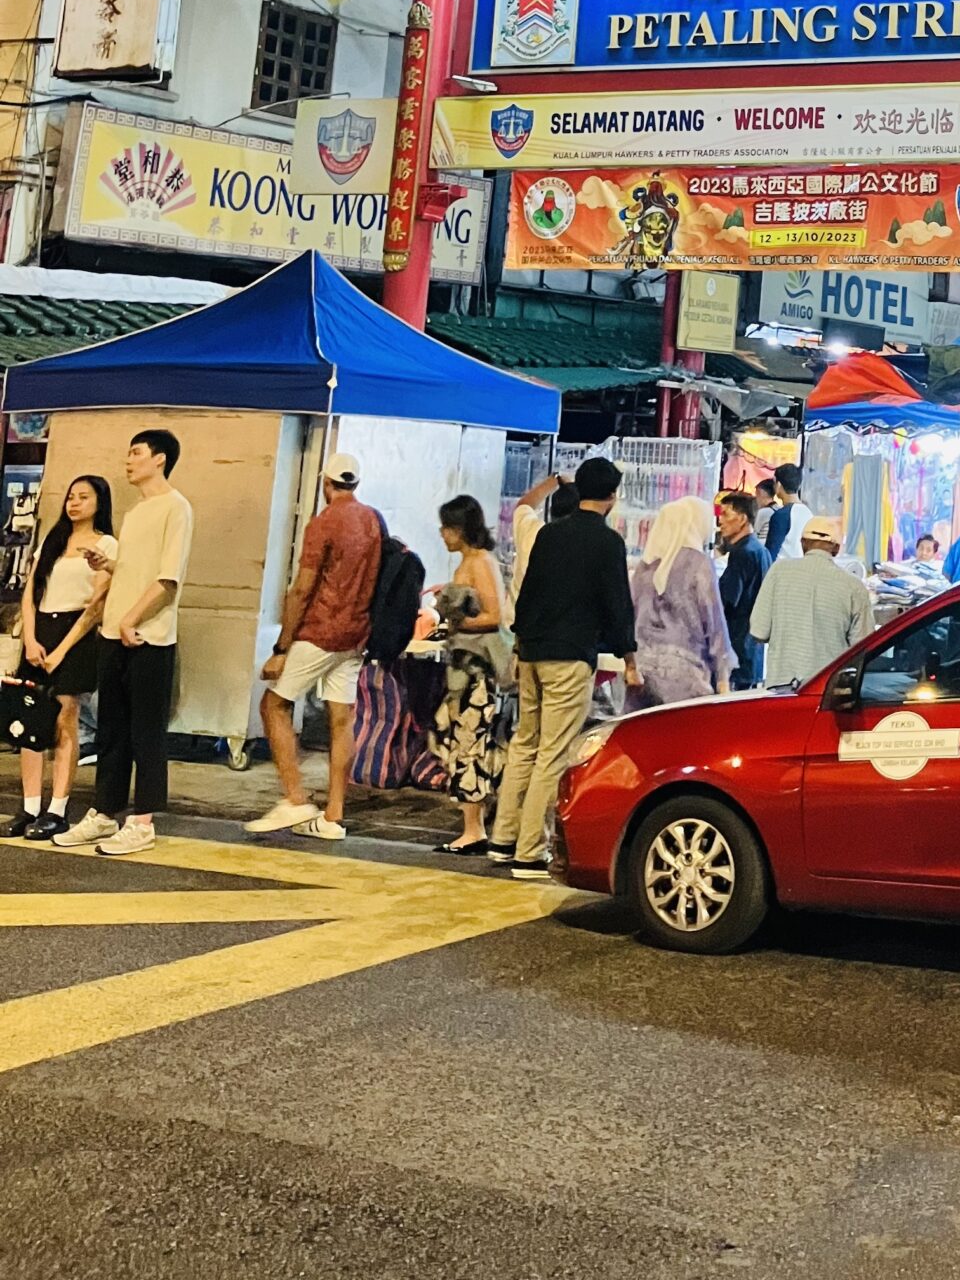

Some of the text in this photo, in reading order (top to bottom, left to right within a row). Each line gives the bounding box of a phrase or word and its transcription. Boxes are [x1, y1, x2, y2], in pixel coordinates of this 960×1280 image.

[606, 5, 841, 49] PETALING
[550, 111, 630, 134] SELAMAT
[633, 109, 705, 132] DATANG
[734, 106, 826, 131] WELCOME
[852, 107, 955, 135] 欢迎光临
[553, 151, 579, 160] KUALA
[580, 151, 613, 159] LUMPUR
[615, 150, 654, 159] HAWKERS
[665, 150, 690, 158] PETTY
[733, 147, 789, 157] ASSOCIATION
[209, 167, 316, 221] KOONG
[755, 200, 868, 222] 吉隆坡茨廠街
[760, 234, 772, 243] 12
[786, 232, 857, 243] 13/10/2023
[780, 301, 814, 320] AMIGO
[820, 270, 915, 327] HOTEL
